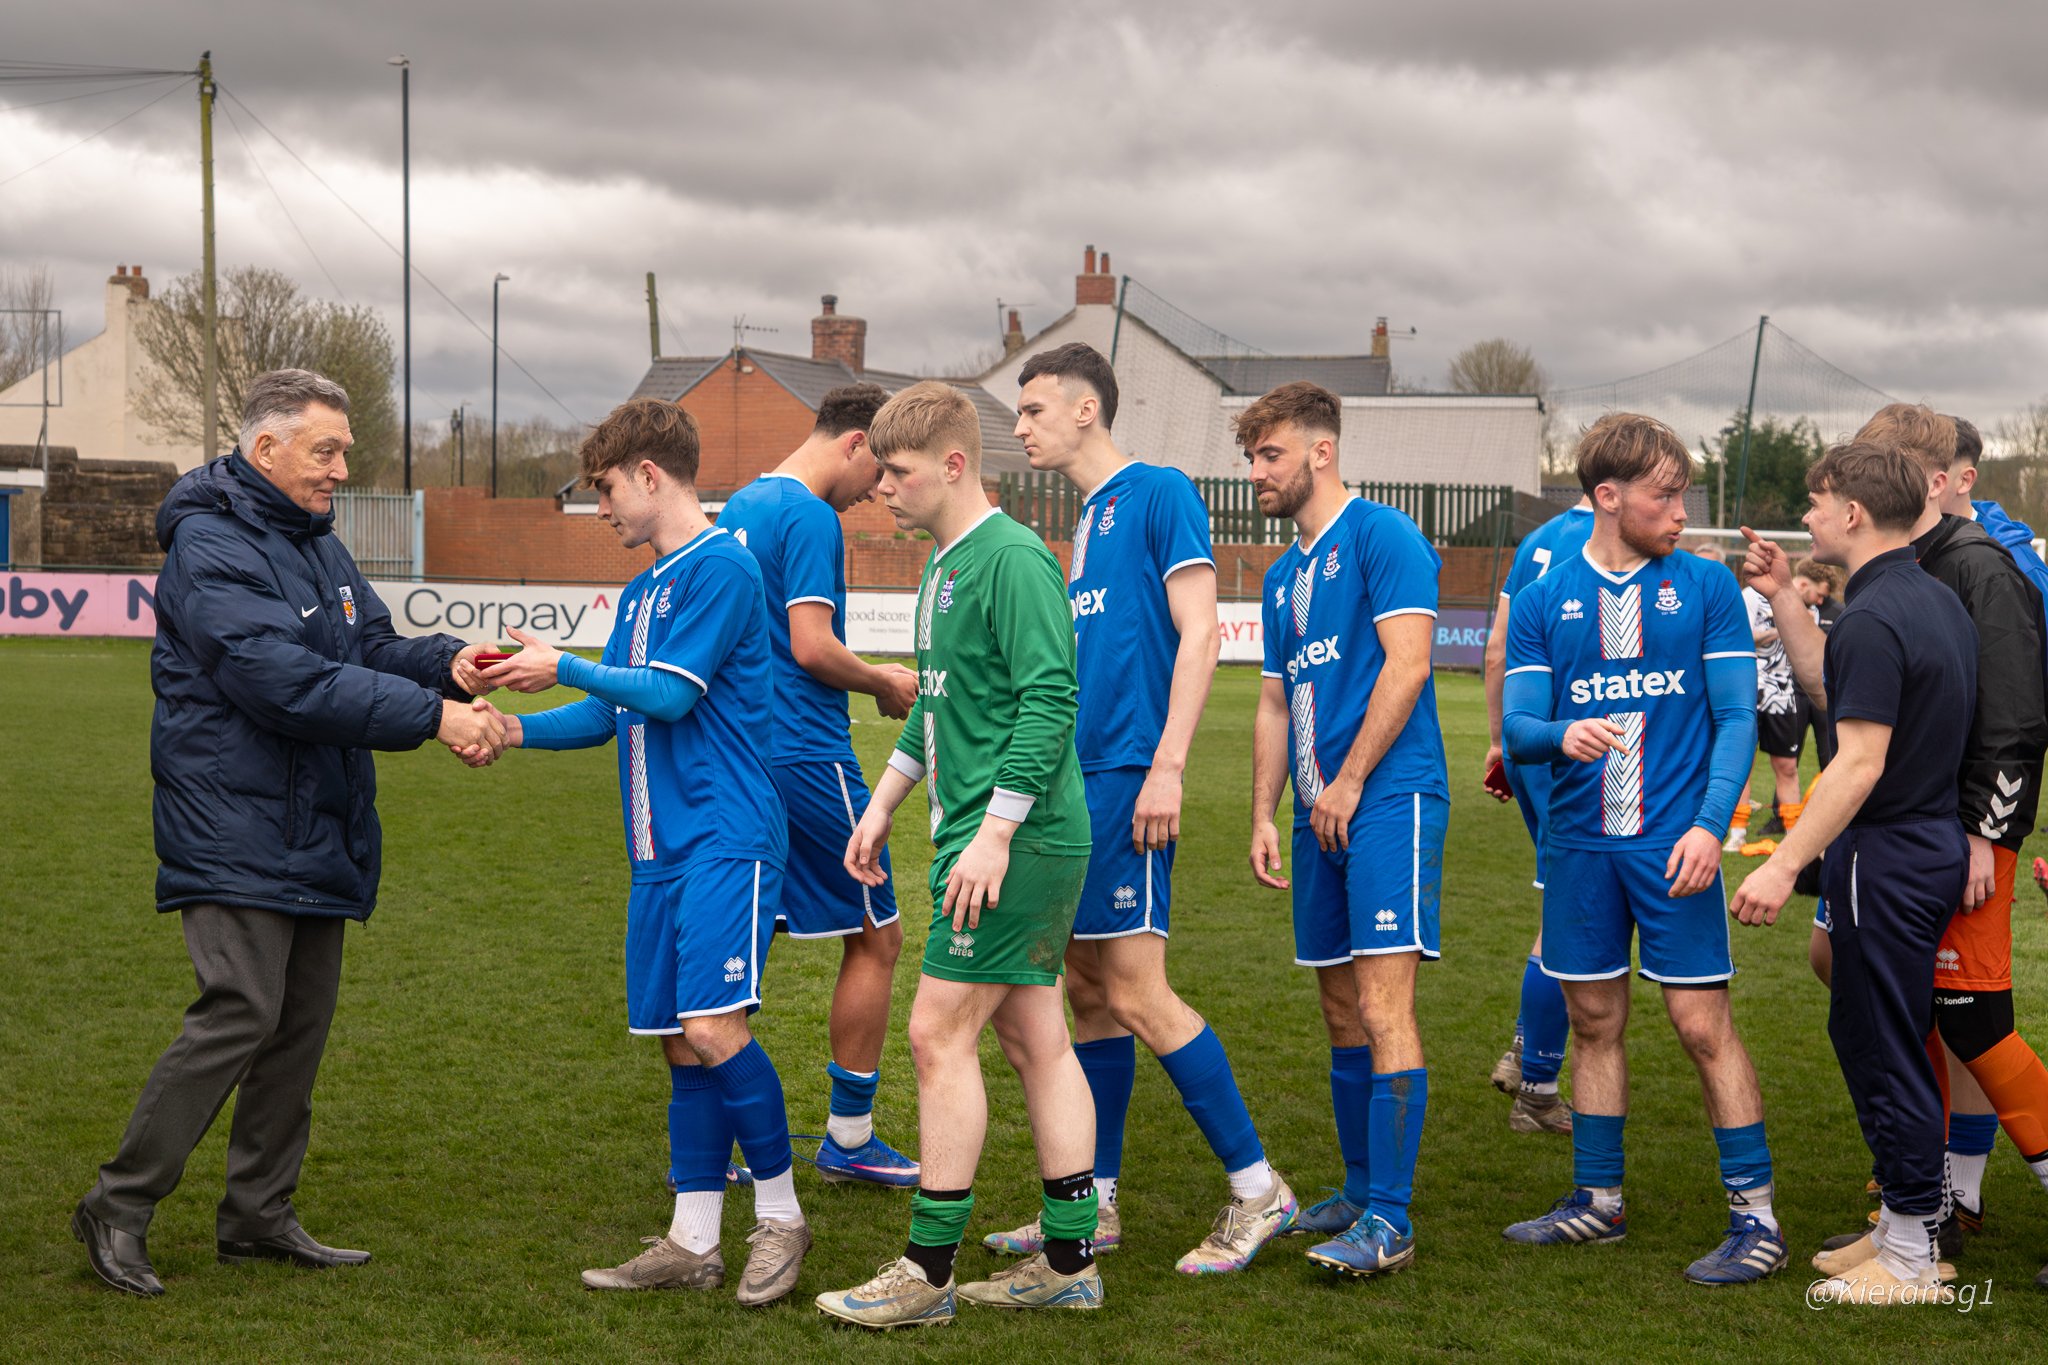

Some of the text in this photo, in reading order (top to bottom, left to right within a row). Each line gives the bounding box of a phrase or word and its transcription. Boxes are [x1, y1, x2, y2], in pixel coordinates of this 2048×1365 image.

[0, 576, 89, 631] by
[404, 588, 588, 640] Corpay
[878, 610, 912, 623] score
[1219, 621, 1265, 641] AYT
[1436, 626, 1493, 647] BARC
[1570, 668, 1686, 704] statex
[1943, 996, 1974, 1005] Sondico
